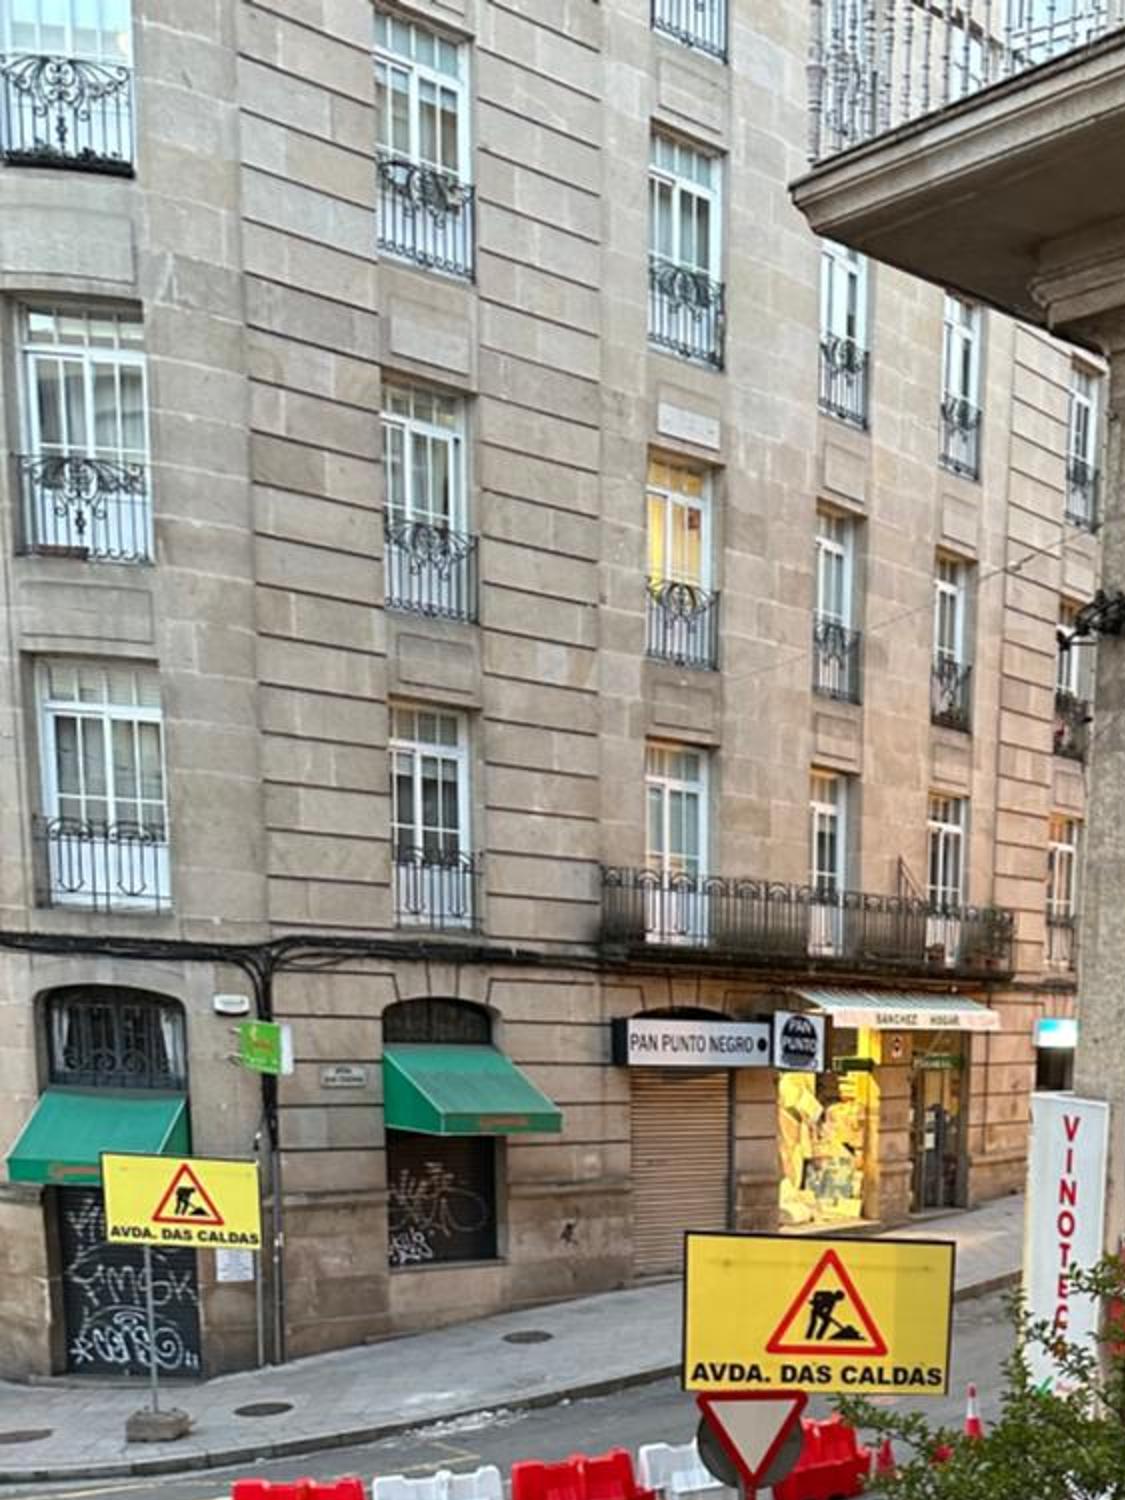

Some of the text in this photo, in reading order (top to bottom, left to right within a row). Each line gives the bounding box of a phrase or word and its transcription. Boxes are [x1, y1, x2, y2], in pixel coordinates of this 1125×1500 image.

[787, 1019, 811, 1034] PAN
[630, 1033, 754, 1053] PAN PUNTO NEGRO
[782, 1035, 817, 1053] PUNTO
[110, 1225, 259, 1245] AVDA. DAS CALDAS
[1052, 1114, 1080, 1358] VINOTEC
[691, 1362, 942, 1386] AVDA. DAS CALDAS
